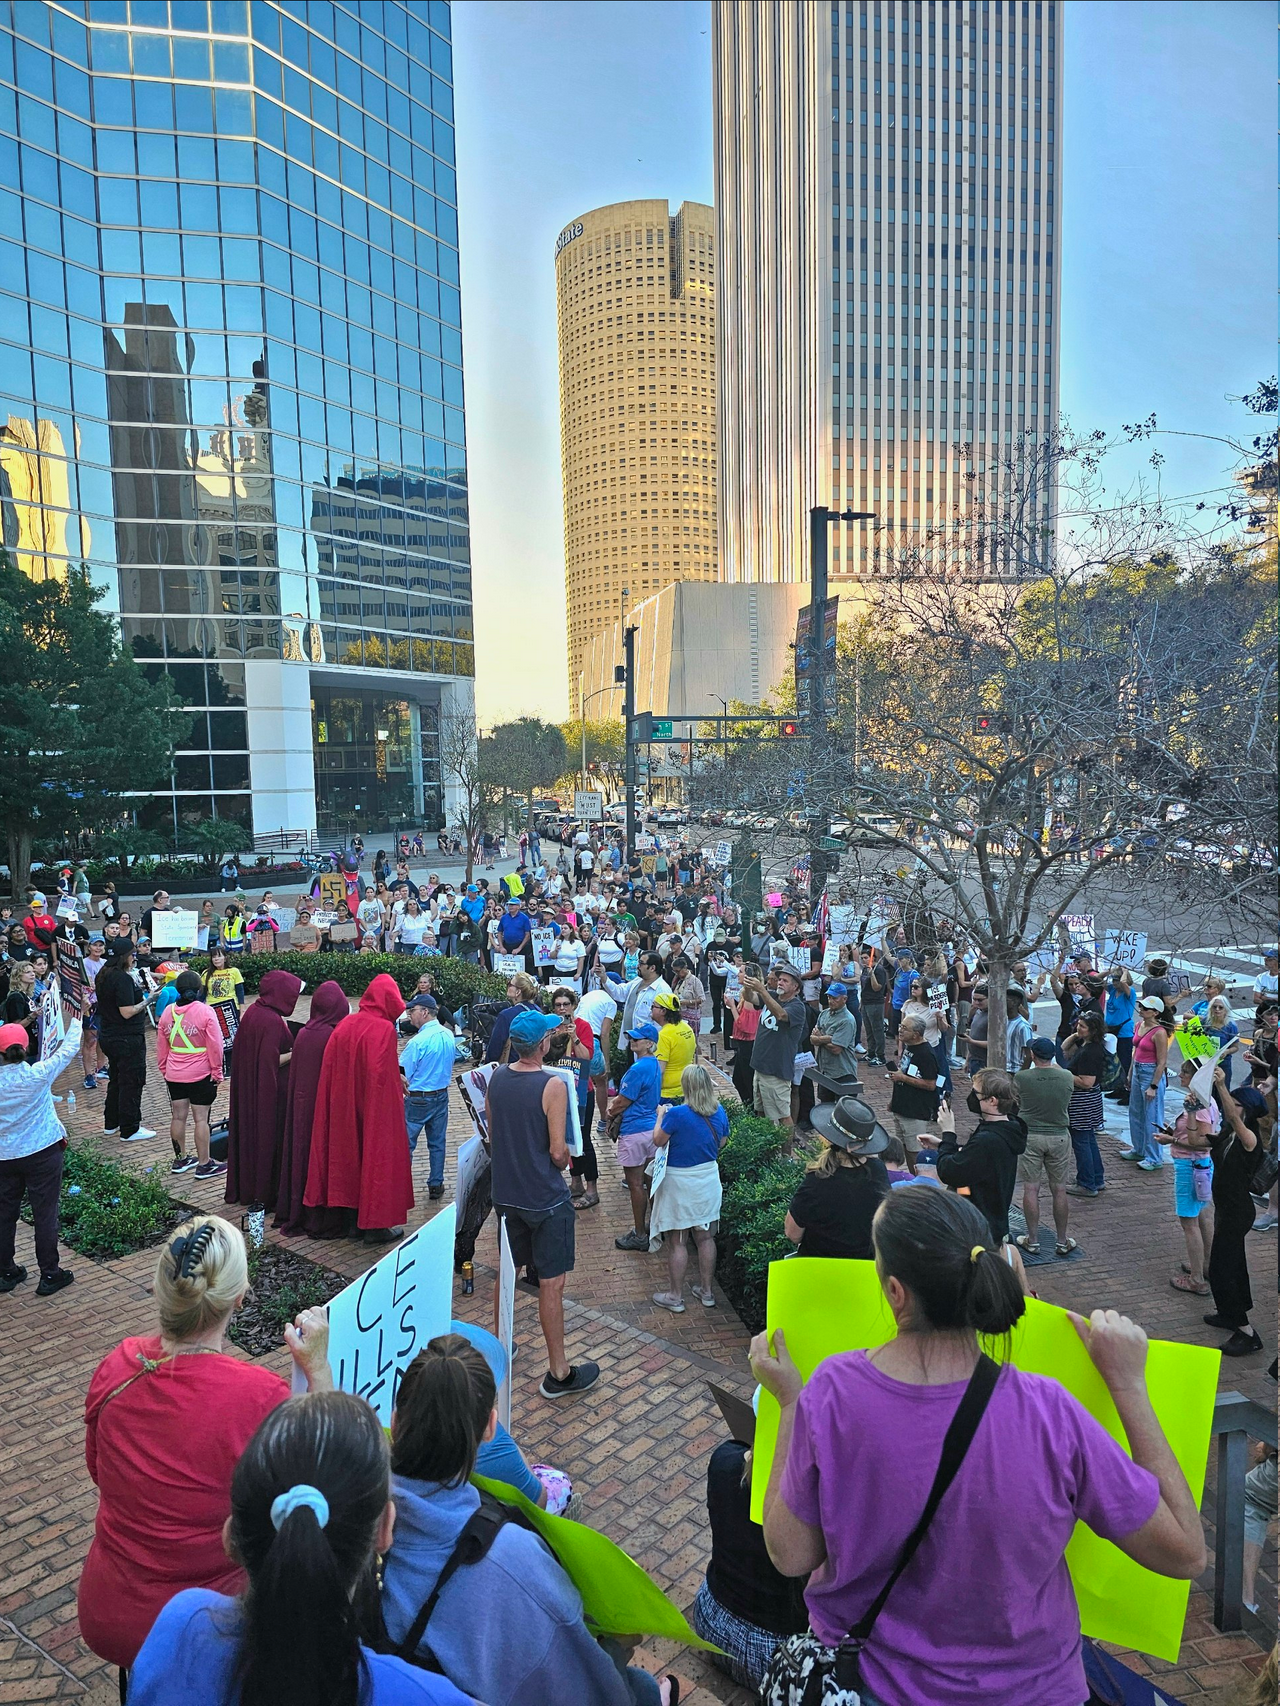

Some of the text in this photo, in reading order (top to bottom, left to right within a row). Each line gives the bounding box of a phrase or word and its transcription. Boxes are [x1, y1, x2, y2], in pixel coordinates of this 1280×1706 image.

[1110, 931, 1139, 946] WAKE
[1115, 949, 1136, 962] UP!
[931, 986, 939, 994] ICE
[222, 1005, 235, 1026] QUIET
[572, 1061, 581, 1069] NO
[340, 1304, 416, 1396] ILLS
